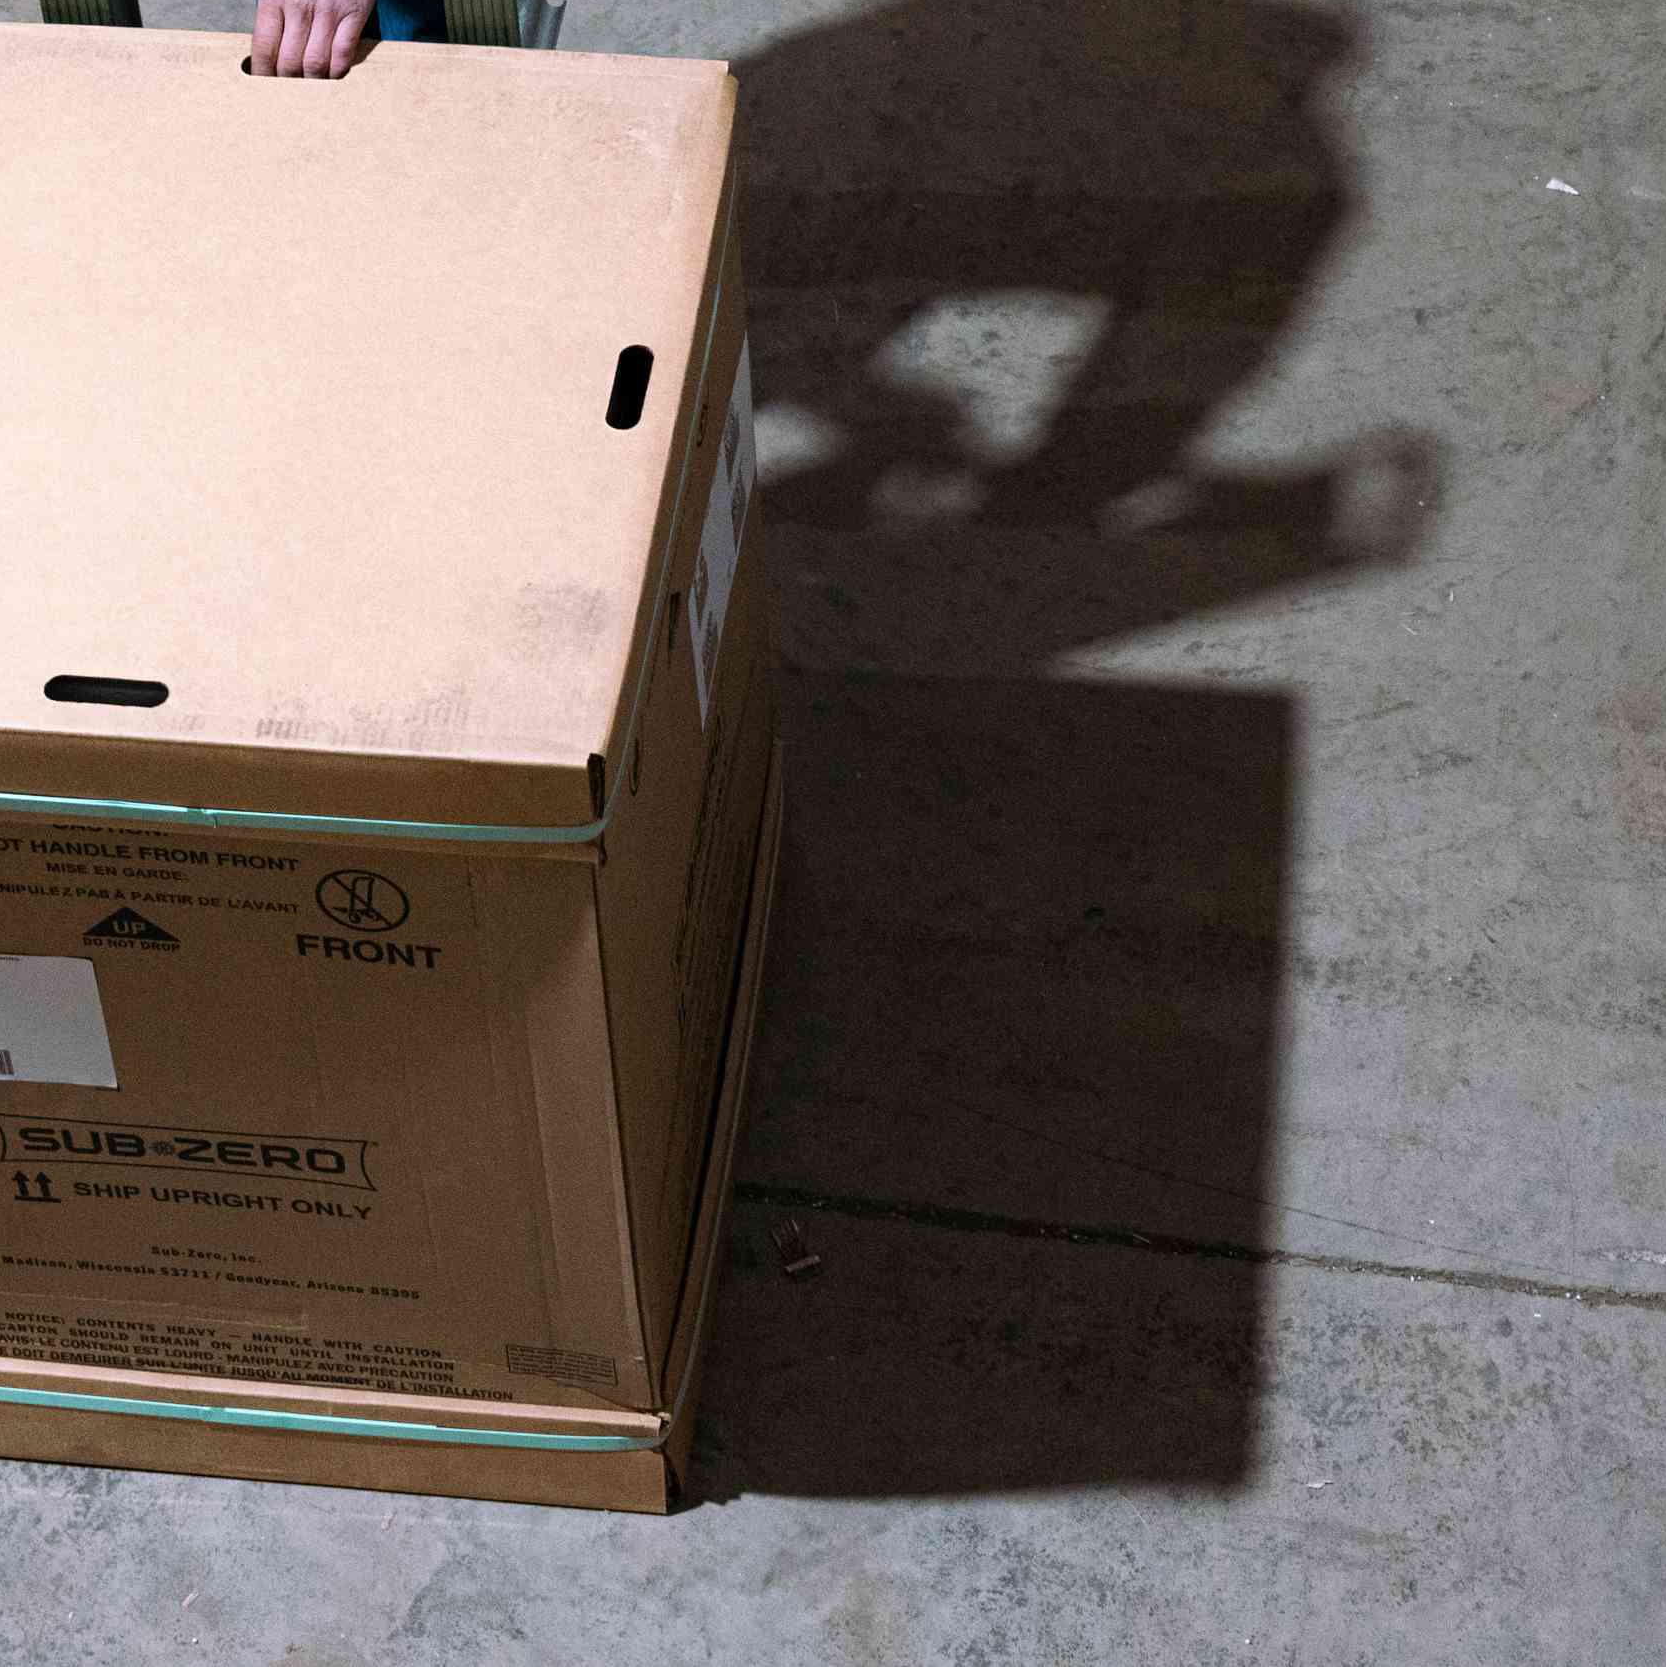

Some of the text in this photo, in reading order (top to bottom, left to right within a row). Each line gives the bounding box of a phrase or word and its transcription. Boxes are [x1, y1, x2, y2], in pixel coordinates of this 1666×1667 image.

[30, 838, 132, 860] HANDLE
[138, 845, 209, 866] FROM
[216, 850, 302, 873] FRONT
[45, 861, 189, 882] MISE EN GARDE:
[76, 886, 111, 901] PAS
[130, 889, 193, 907] PARTIR
[197, 895, 221, 909] DE
[226, 898, 302, 915] L'AVANT
[82, 936, 182, 954] DO NOT DROP
[112, 919, 148, 936] UP
[295, 933, 443, 969] FRONT
[18, 1126, 348, 1175] SUB ZERO
[72, 1180, 372, 1221] SHIP UPRIGHT ONLY
[150, 1245, 262, 1263] Sub-Zero, Inc.
[0, 1255, 73, 1270] Madison,
[75, 1259, 156, 1275] Wisconsin
[160, 1265, 210, 1280] 53711
[226, 1271, 301, 1288] Goodyear,
[307, 1278, 364, 1294] Arizona
[4, 1310, 443, 1359] NOTICE: CONTENTS HEAVY HANDLE WITH CAUTION
[68, 1328, 130, 1342] SHOULD
[139, 1333, 201, 1349] REMAIN
[209, 1339, 233, 1352] ON
[242, 1343, 279, 1357] UNIT
[289, 1346, 334, 1361] UNTIL
[344, 1350, 456, 1372] INSTALLATION
[12, 1346, 45, 1360] DOIT
[49, 1350, 134, 1369] DEMEURER
[306, 1373, 370, 1387] MOMENT
[375, 1378, 397, 1391] DE
[399, 1380, 514, 1401] L'INSTALLATION
[36, 1337, 56, 1348] LE
[59, 1337, 129, 1354] CONTENU
[133, 1344, 160, 1357] EST
[163, 1347, 215, 1362] LOURD
[225, 1352, 314, 1371] MANIPULEZ
[319, 1361, 355, 1375] AVEC
